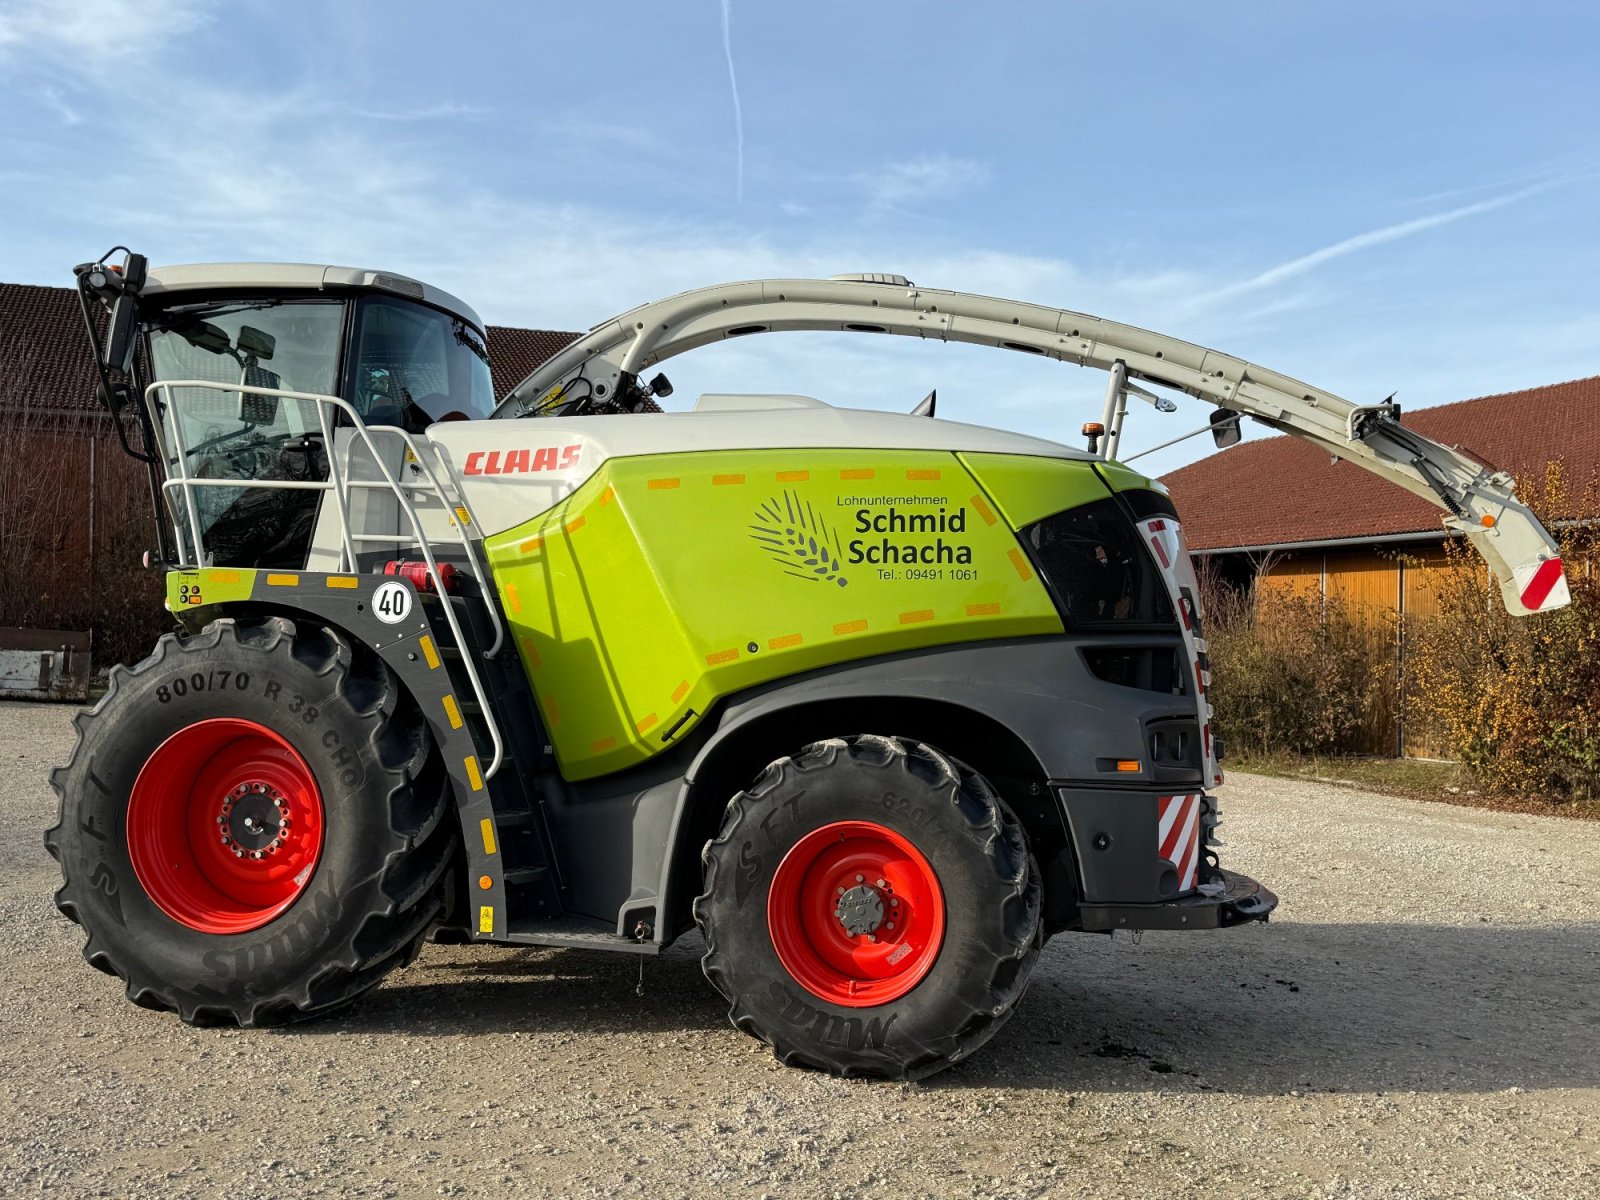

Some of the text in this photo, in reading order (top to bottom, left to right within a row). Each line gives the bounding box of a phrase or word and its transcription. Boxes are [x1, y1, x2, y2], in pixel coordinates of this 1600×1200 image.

[464, 445, 582, 476] CLAAS
[837, 495, 948, 507] Lohnunternehmen
[855, 507, 966, 533] Schmid
[848, 538, 972, 564] Schacha
[877, 569, 978, 580] Tel.: 09491 1061
[379, 589, 404, 616] 40
[155, 670, 359, 787] 800/70 R 38 CHO
